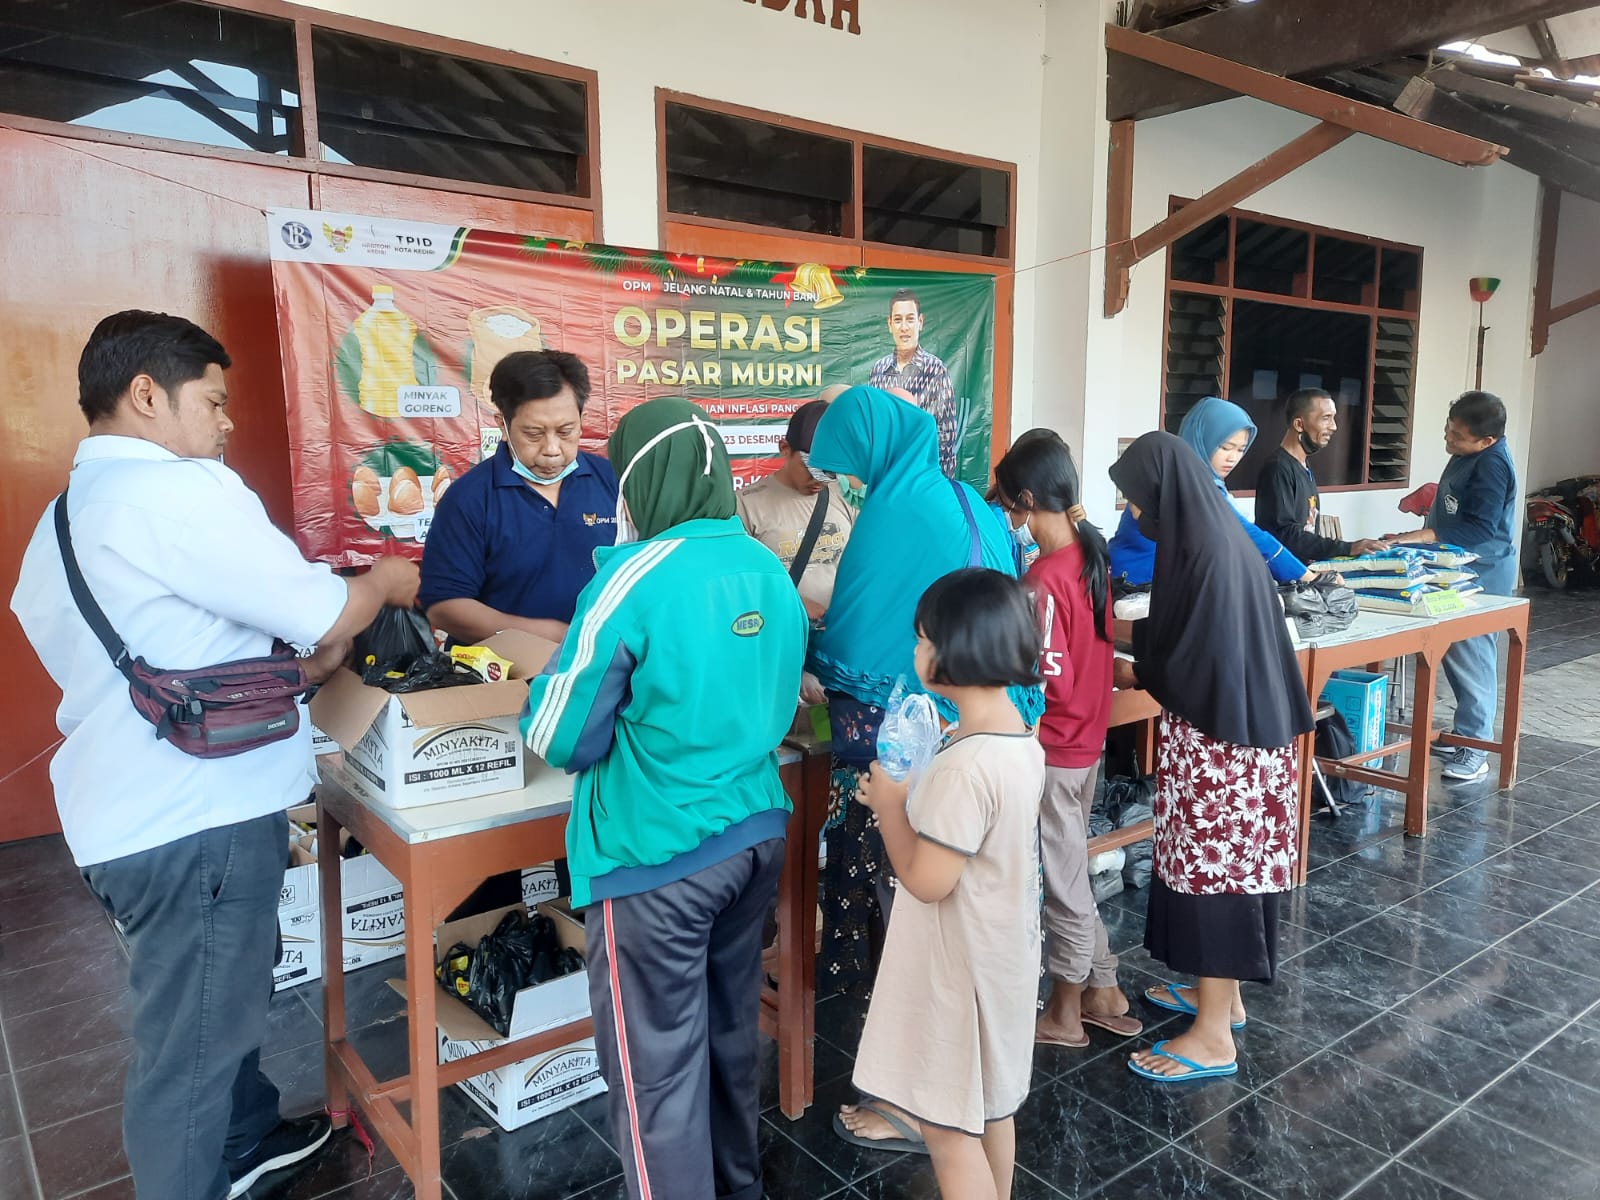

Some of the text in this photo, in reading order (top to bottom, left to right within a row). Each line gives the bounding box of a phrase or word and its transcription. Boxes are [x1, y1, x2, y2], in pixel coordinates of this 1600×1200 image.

[395, 235, 433, 247] TPID
[622, 280, 651, 292] OPM
[663, 281, 820, 302] JELANG NATAL & TAHUN BARU
[613, 305, 821, 353] OPERASI
[616, 359, 822, 387] PASAR MURNI
[404, 391, 448, 400] MINYAK
[404, 404, 452, 413] GORENG
[705, 404, 799, 414] IAN INFLASI PANG
[724, 434, 788, 445] 23 DESEMBE
[423, 735, 499, 761] MINYAKITA
[408, 773, 421, 782] ISI
[429, 769, 449, 779] 1000
[451, 766, 464, 775] ML
[467, 765, 473, 773] X
[475, 763, 486, 772] 12
[487, 759, 512, 769] REFIL
[522, 879, 558, 896] YAKIT
[351, 911, 405, 931] YAKITA
[532, 1056, 591, 1088] MINYAKITA
[520, 1100, 531, 1108] ISI
[536, 1091, 553, 1101] 1000
[553, 1086, 564, 1095] ML
[572, 1079, 580, 1087] 12
[581, 1071, 600, 1084] REFIL
